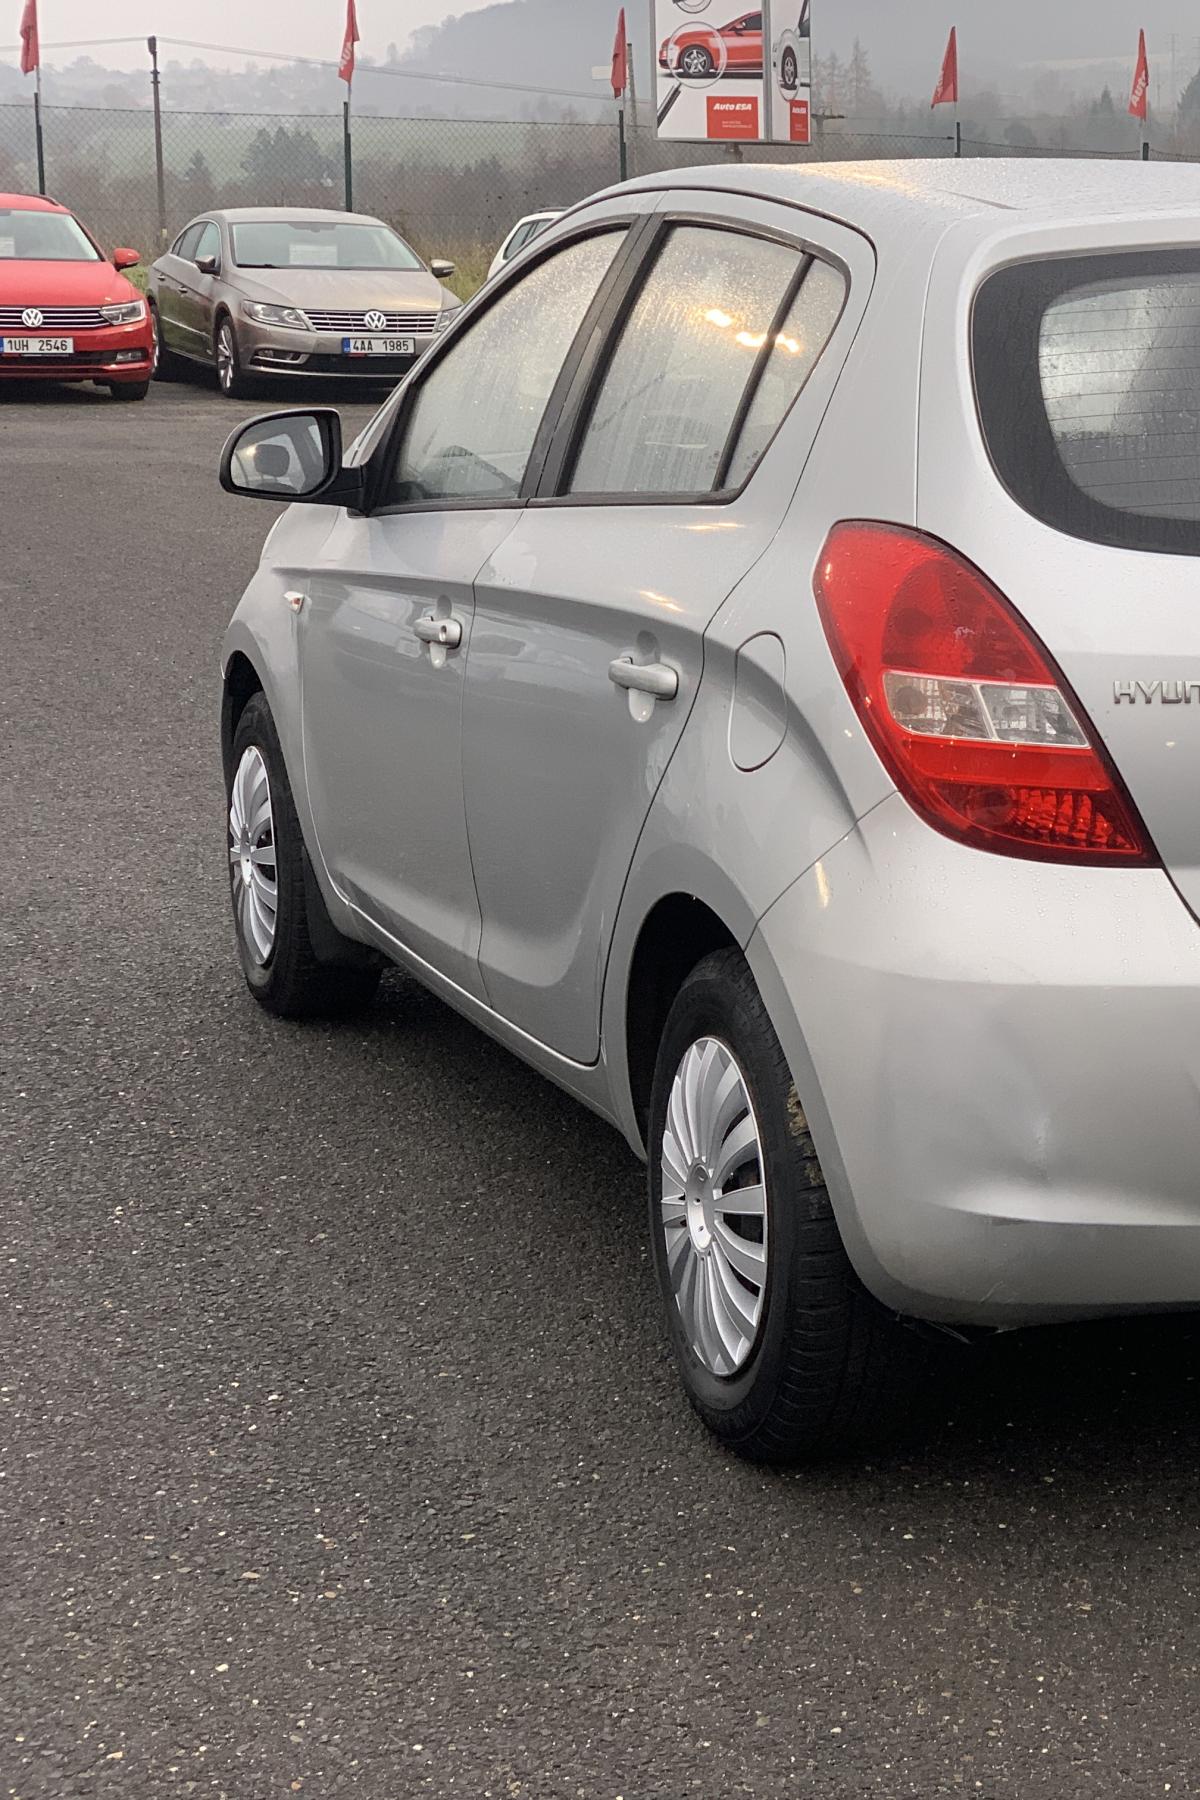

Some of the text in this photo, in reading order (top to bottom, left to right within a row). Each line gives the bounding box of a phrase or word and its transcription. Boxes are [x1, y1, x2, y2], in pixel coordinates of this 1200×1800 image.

[713, 103, 753, 111] Auto ESA
[7, 340, 68, 351] 1UH 2546
[353, 341, 373, 352] 4AA
[383, 340, 409, 352] 1985
